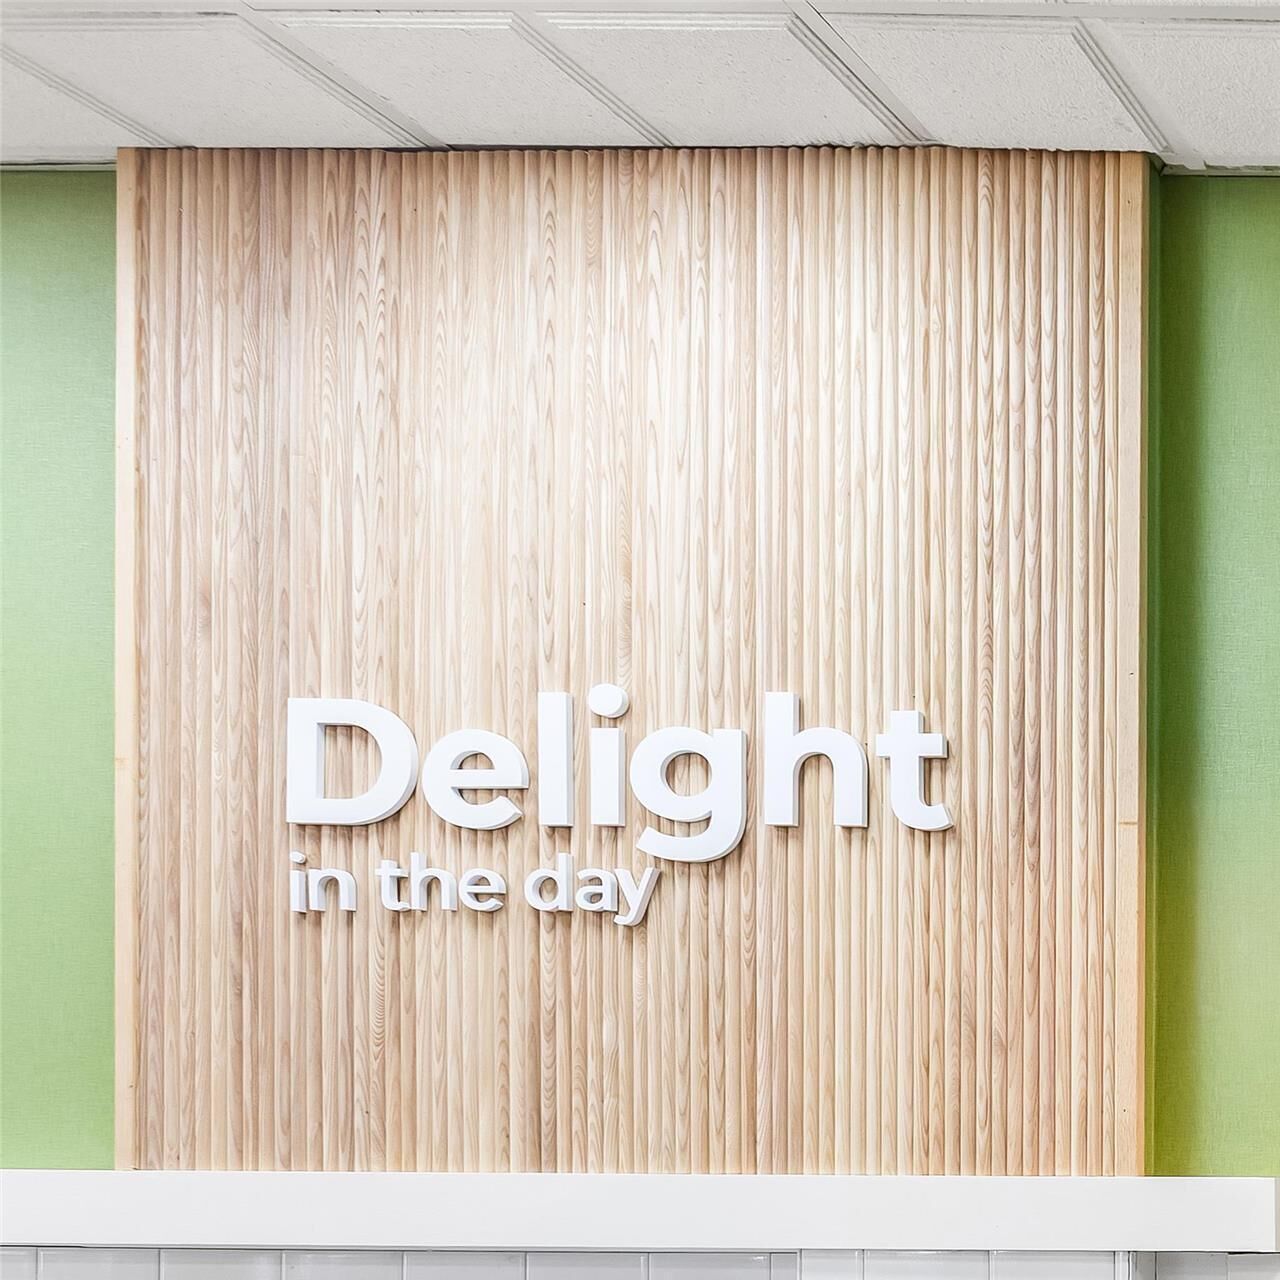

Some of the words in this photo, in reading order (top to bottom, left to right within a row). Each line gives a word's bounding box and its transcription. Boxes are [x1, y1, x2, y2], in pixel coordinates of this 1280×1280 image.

[286, 683, 954, 862] Delight
[290, 851, 356, 912] in
[376, 851, 506, 912] the
[524, 851, 661, 926] day
